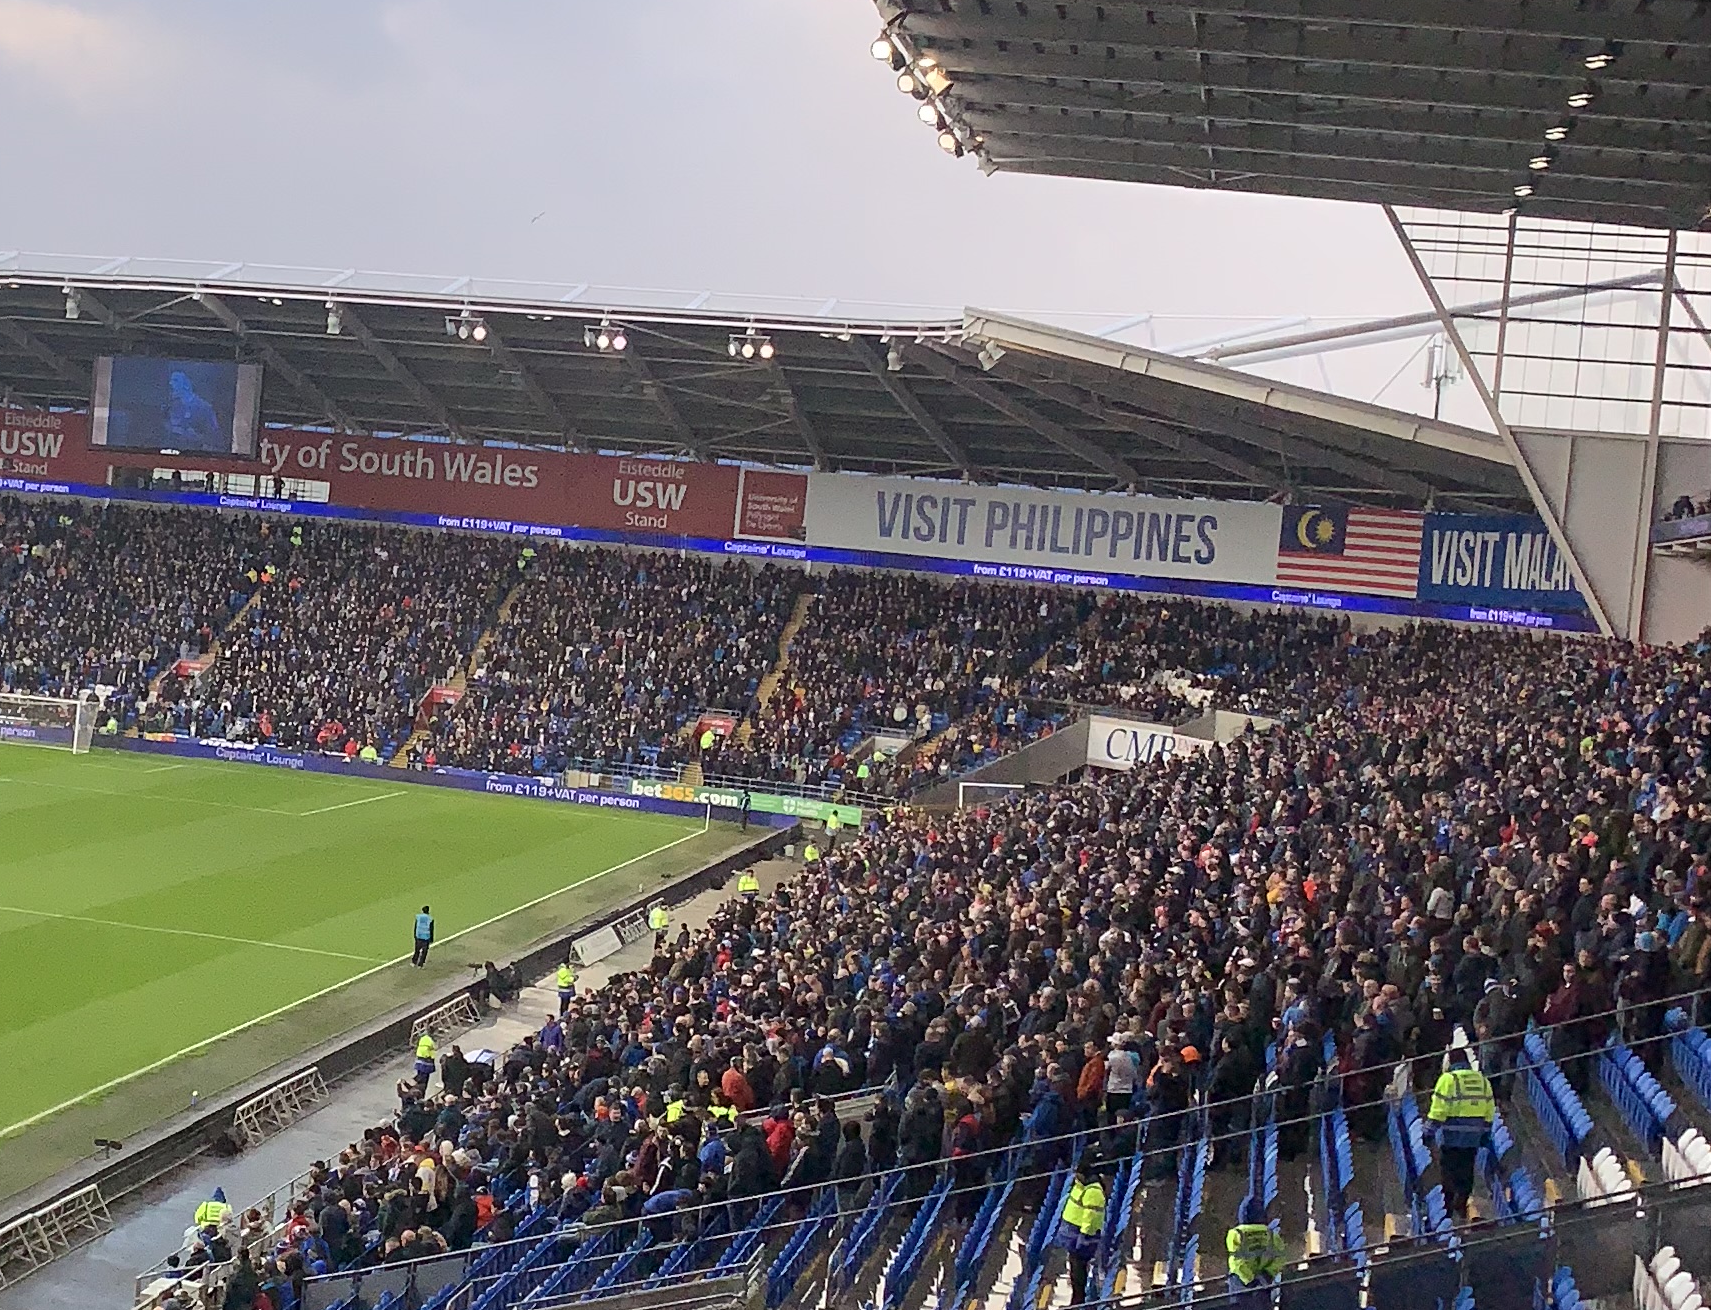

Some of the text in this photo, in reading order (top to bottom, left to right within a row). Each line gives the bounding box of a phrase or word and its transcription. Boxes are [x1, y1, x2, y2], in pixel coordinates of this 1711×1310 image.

[5, 412, 61, 429] Eisteddle
[1, 430, 64, 458] USW
[13, 458, 47, 475] Stand
[297, 439, 331, 469] of
[339, 438, 435, 480] South
[441, 451, 539, 488] Wales
[619, 461, 685, 479] Eisteddle
[219, 496, 291, 512] Captains' Lounge
[613, 479, 687, 510] USW
[439, 516, 562, 536] from £119+VAT per person
[625, 512, 667, 528] Stand
[877, 491, 1218, 565] VISIT PHILIPPINES
[725, 541, 806, 559] Captains' Lounge
[1431, 530, 1499, 587] VISIT
[974, 564, 1109, 586] from £119+VAT per person
[216, 747, 303, 768] Captains' Lounge
[486, 780, 639, 809] from £119+VAT per person
[631, 780, 737, 807] bet365.com
